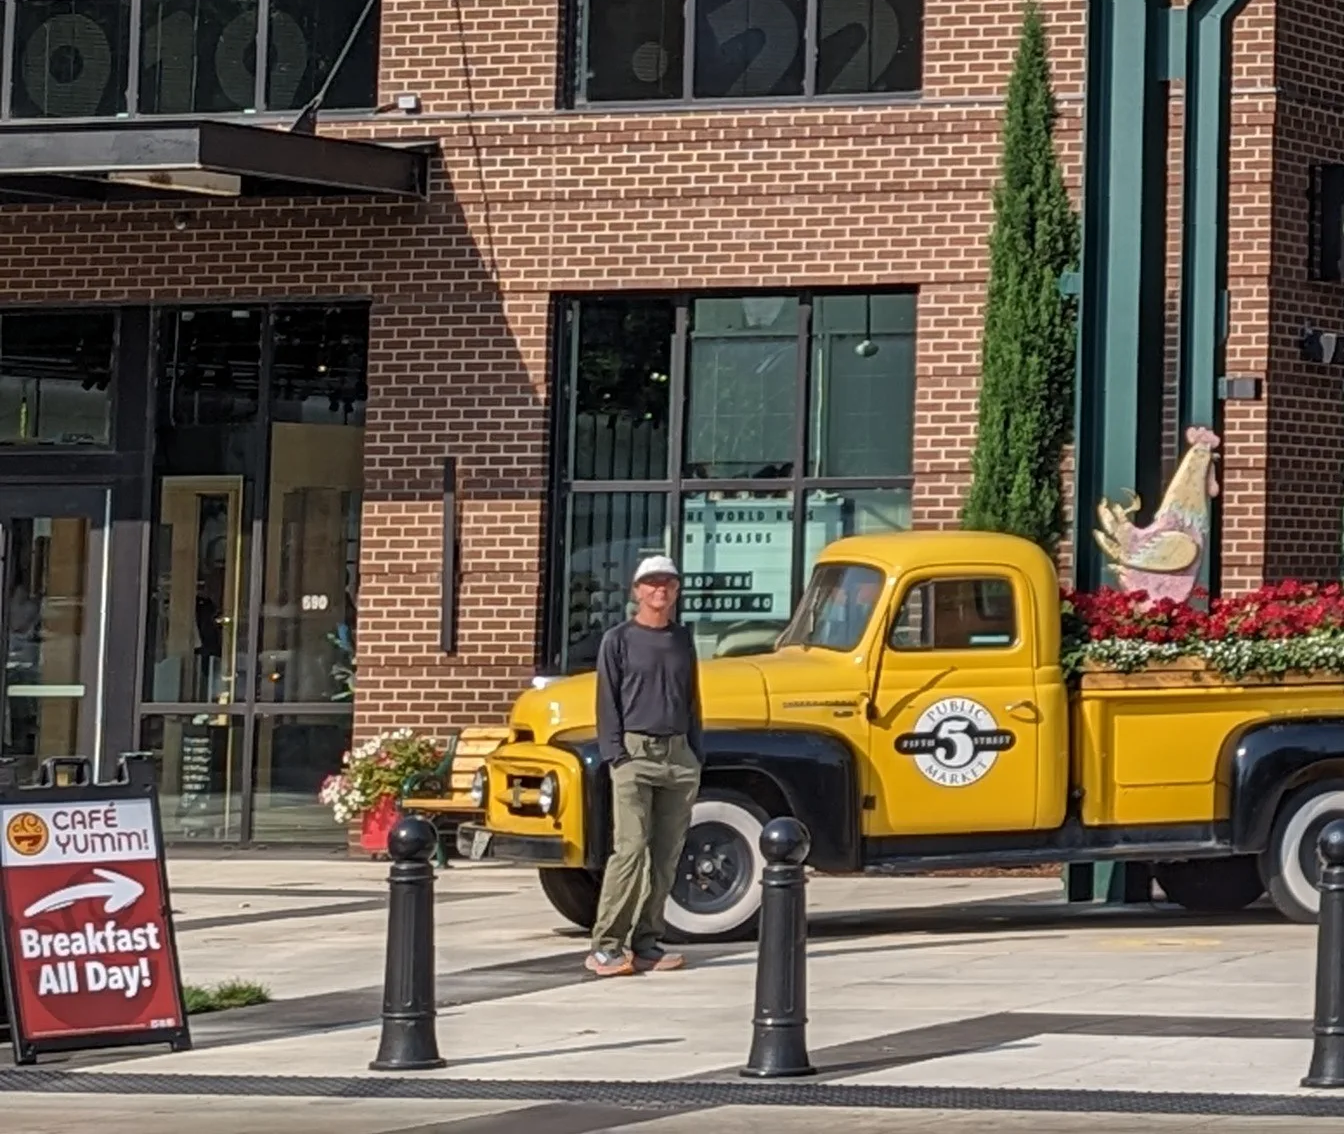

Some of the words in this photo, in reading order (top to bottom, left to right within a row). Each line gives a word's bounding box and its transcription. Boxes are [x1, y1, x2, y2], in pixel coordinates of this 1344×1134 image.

[715, 510, 765, 522] WORLD
[775, 509, 814, 521] RUS
[705, 532, 773, 544] PEGASUS
[684, 575, 714, 586] HOP
[724, 575, 752, 586] THE
[684, 596, 742, 609] EGASUS
[926, 699, 987, 723] PUBLIC
[901, 738, 936, 749] FIFTH
[934, 719, 976, 767] 5
[972, 734, 1012, 746] STREET
[924, 759, 988, 784] MARKET
[52, 801, 118, 831] CAFÉ
[19, 921, 162, 959] Breakfast
[38, 960, 79, 997] All
[85, 957, 153, 998] Day!
